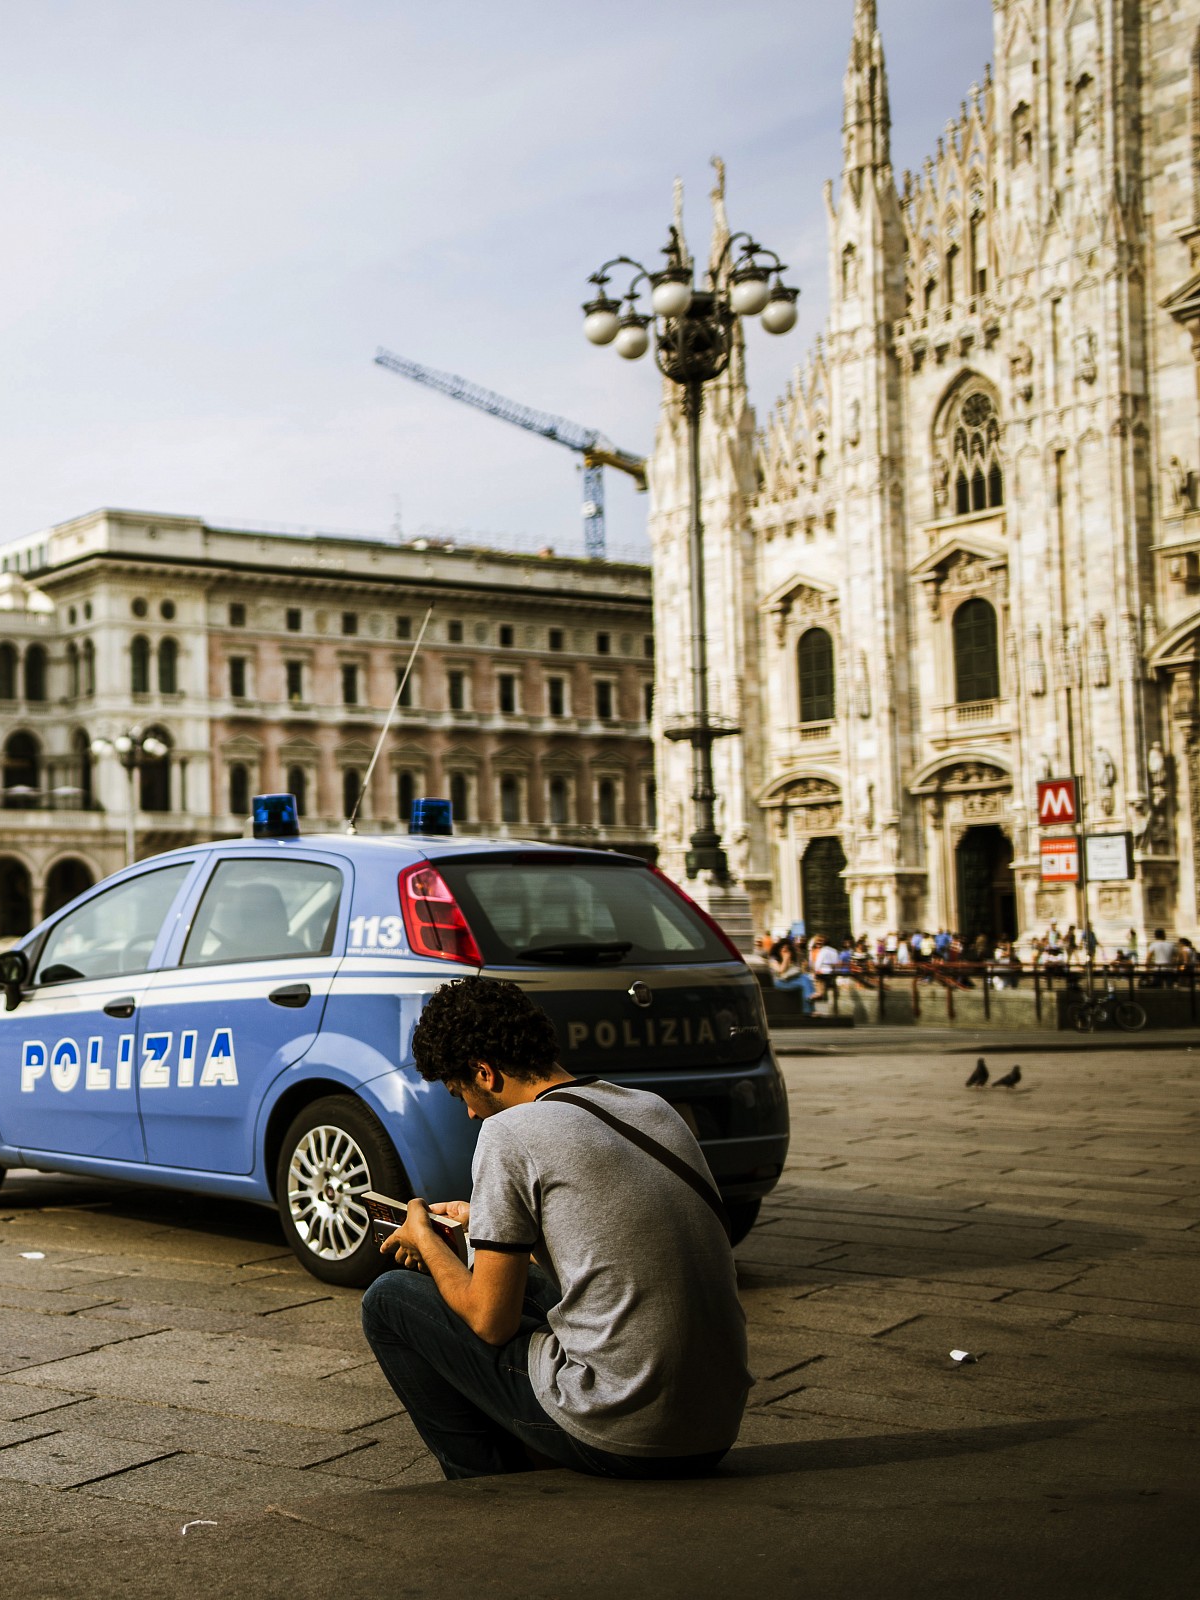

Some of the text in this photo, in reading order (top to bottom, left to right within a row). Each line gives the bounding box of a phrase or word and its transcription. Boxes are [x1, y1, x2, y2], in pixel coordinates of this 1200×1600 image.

[1041, 787, 1074, 817] M
[349, 915, 403, 948] 113
[568, 1017, 716, 1049] POLIZIA
[20, 1027, 239, 1093] POLIZIA
